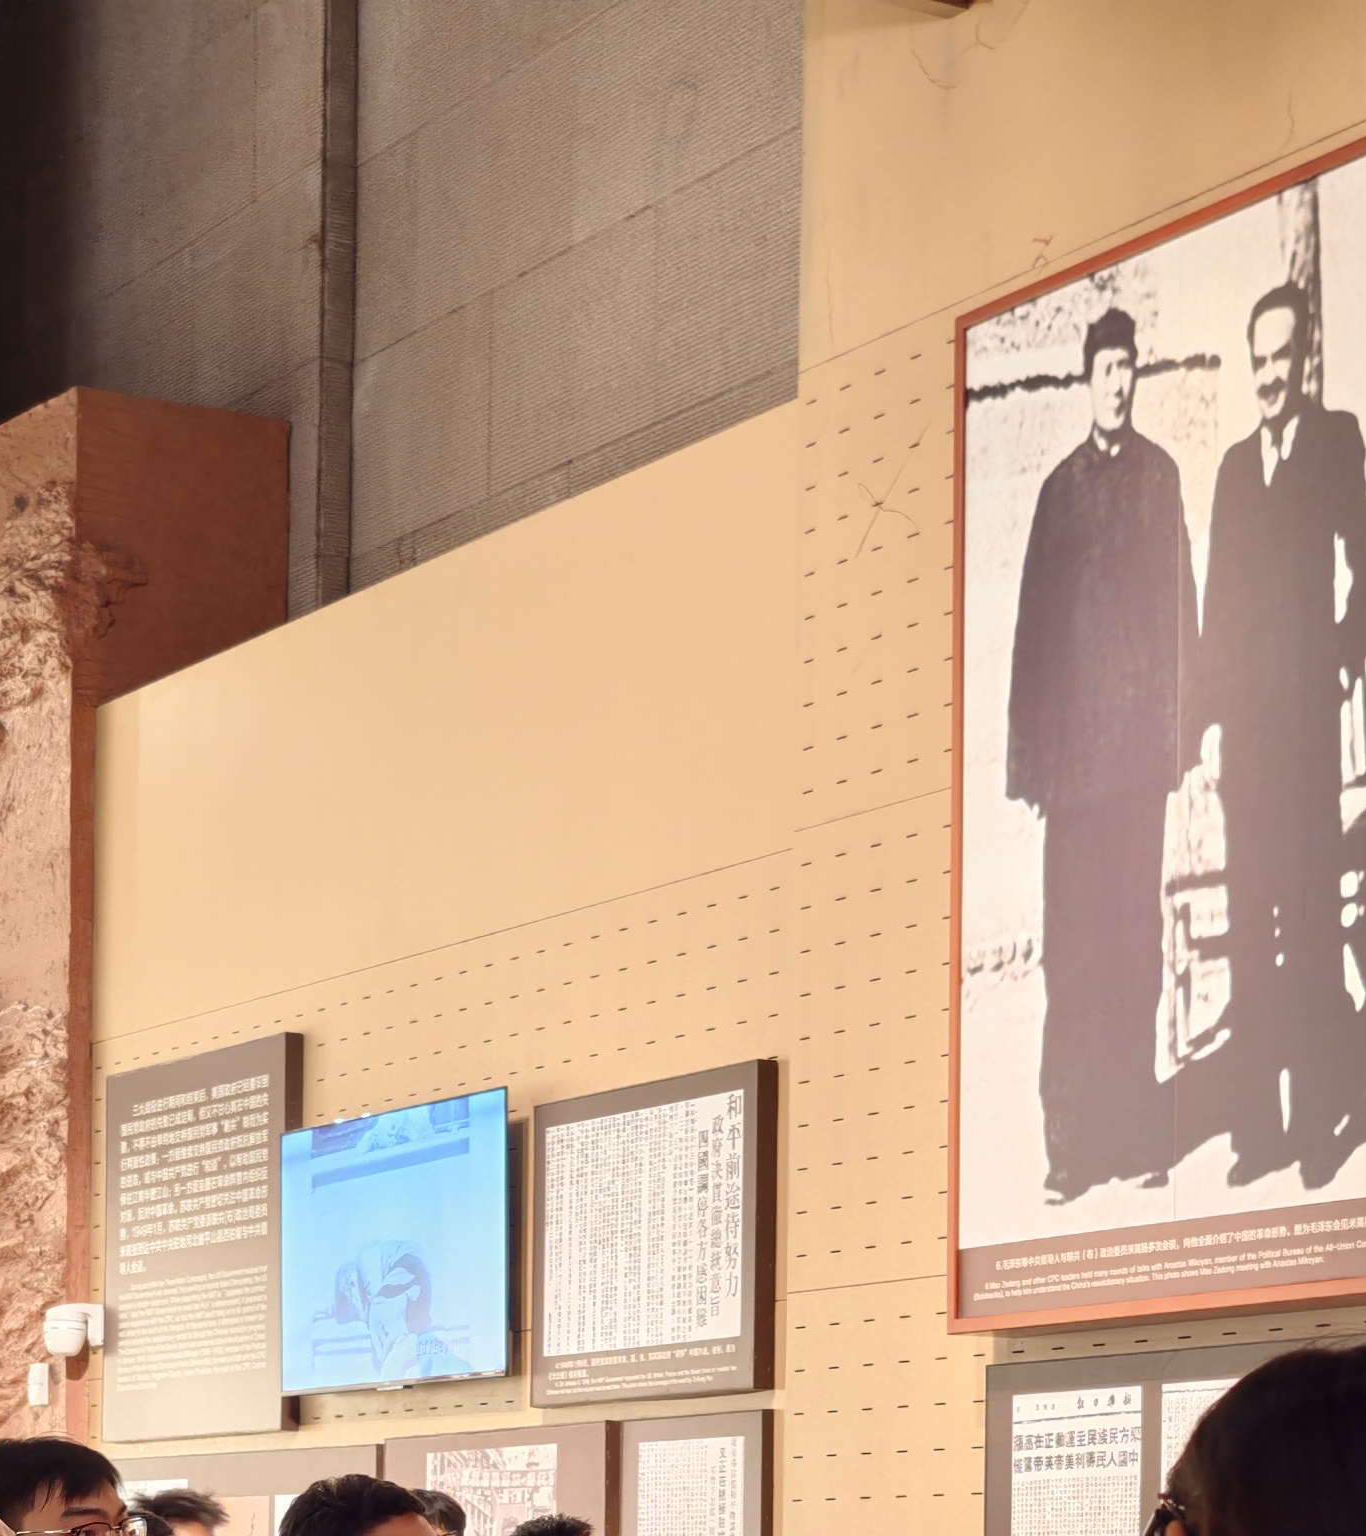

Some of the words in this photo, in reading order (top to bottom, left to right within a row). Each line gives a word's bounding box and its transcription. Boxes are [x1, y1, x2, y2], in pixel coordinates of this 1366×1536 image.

[726, 1093, 742, 1298] 和平前途待努力
